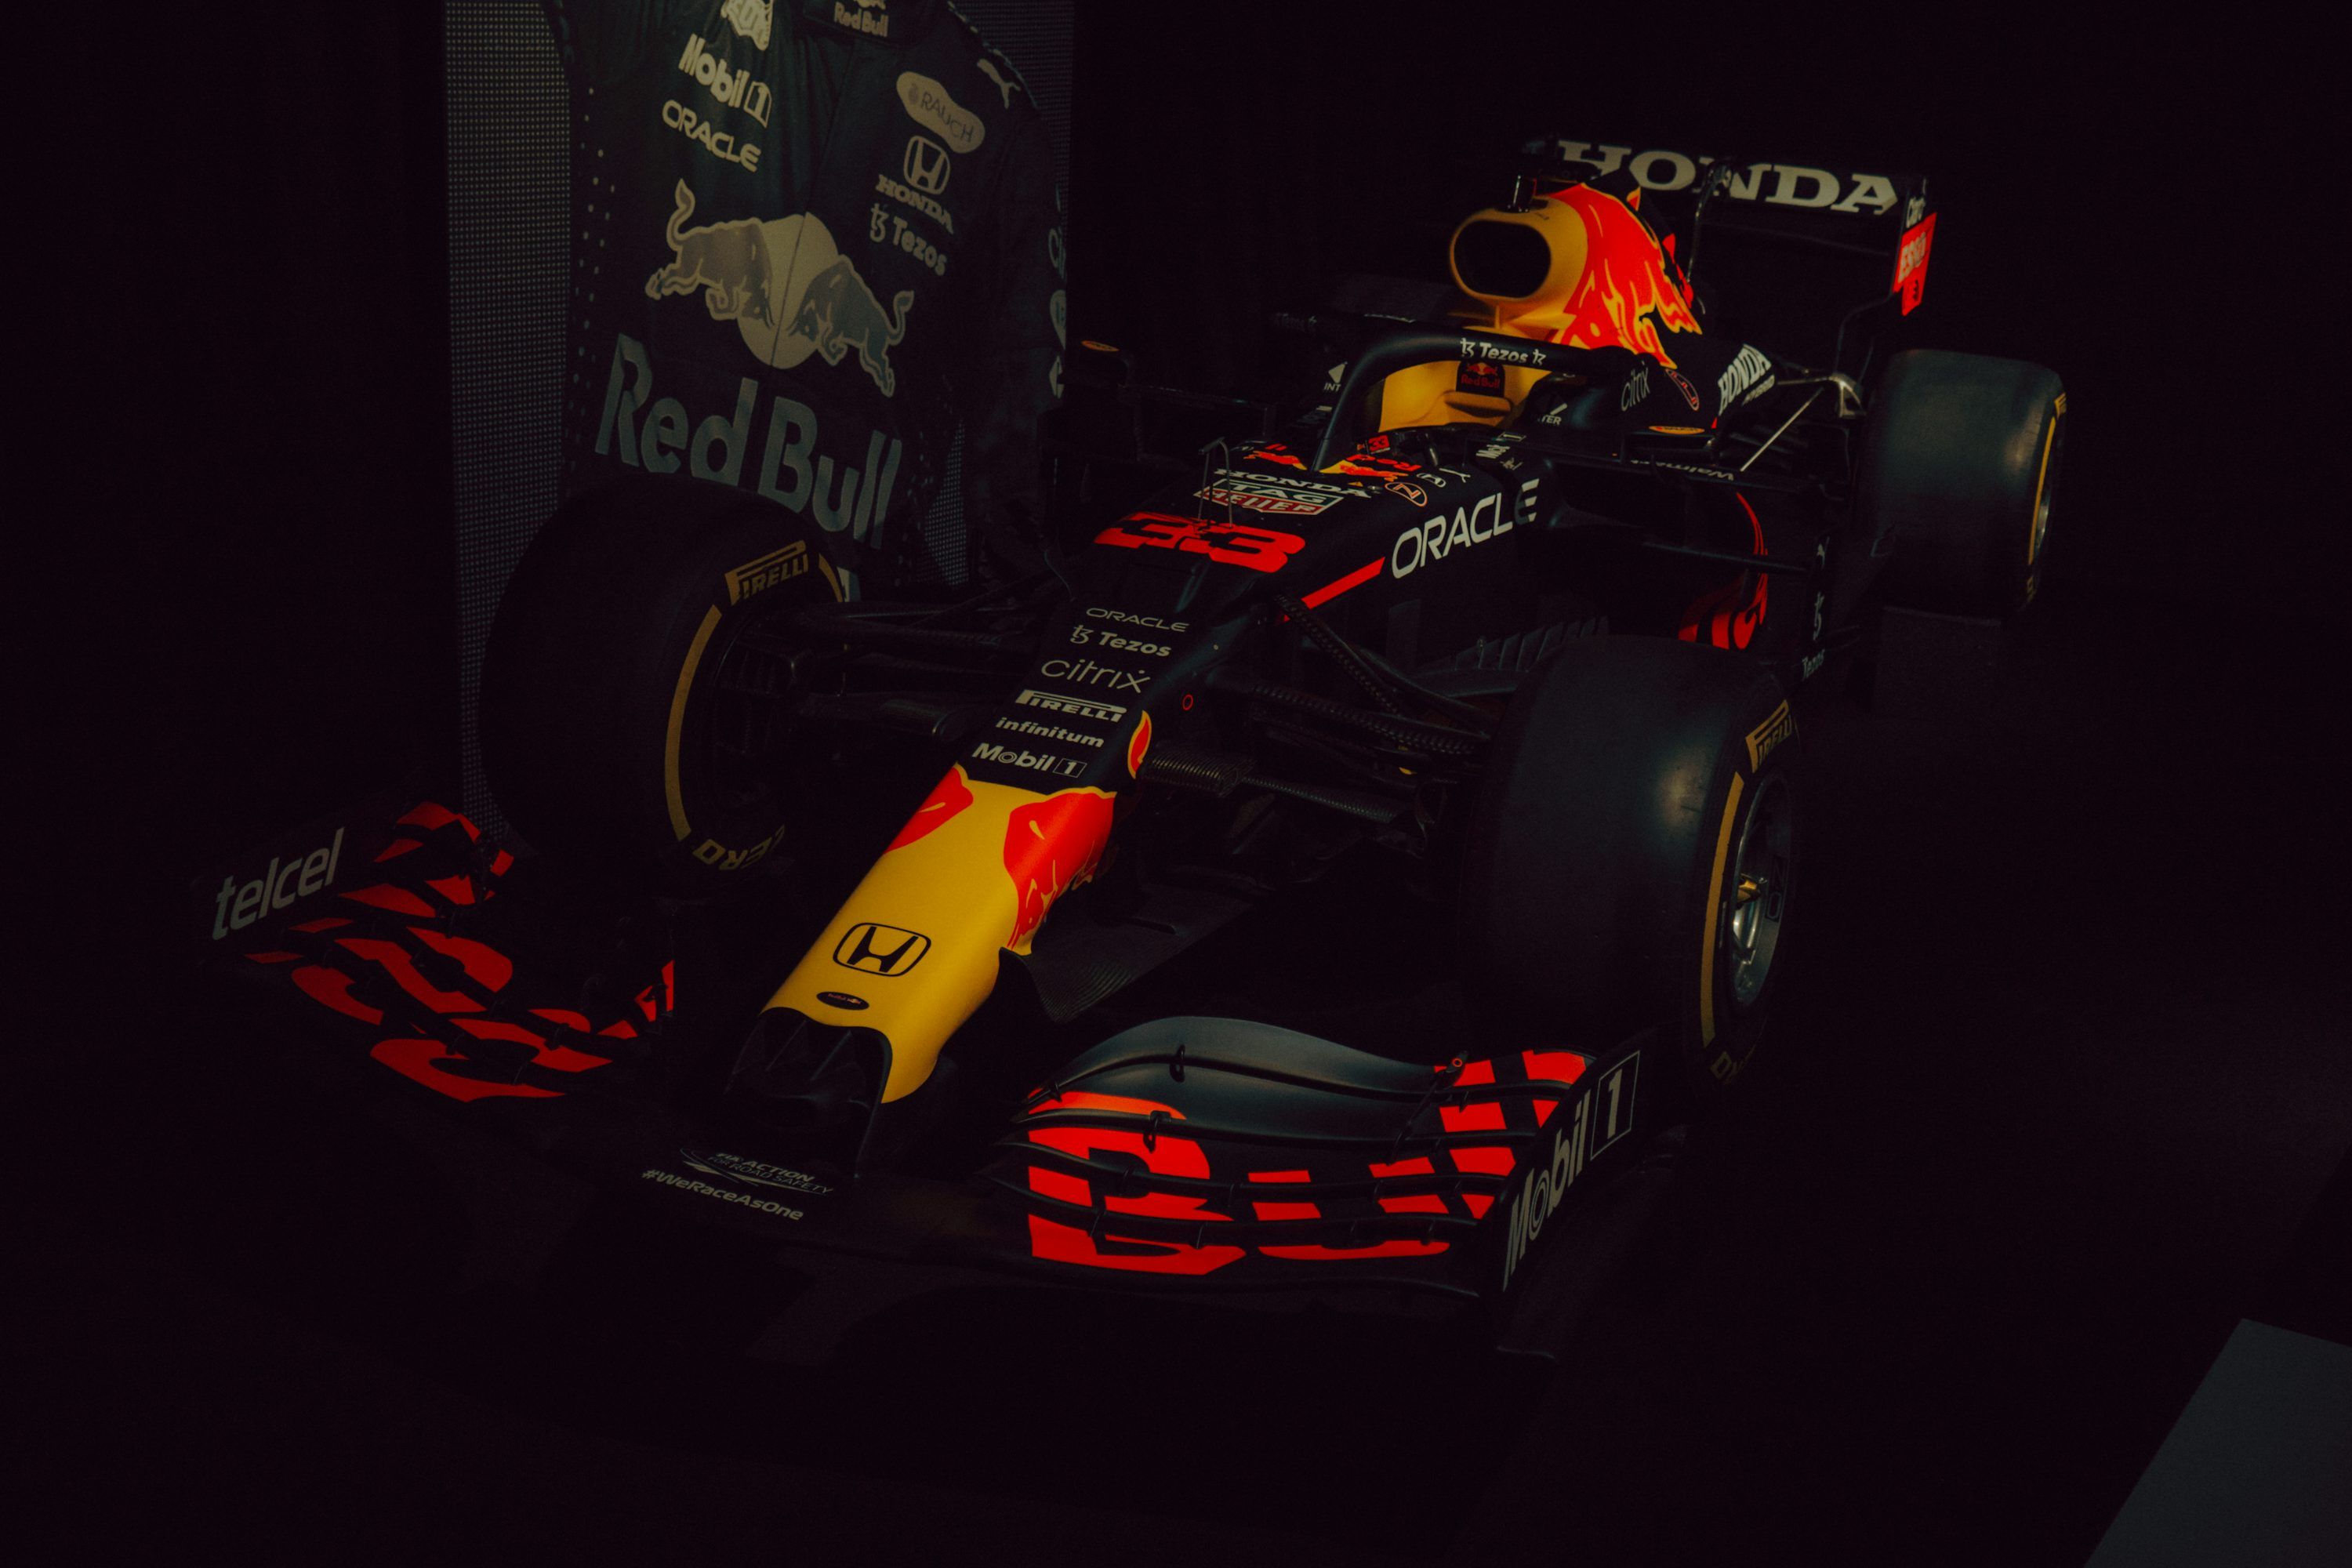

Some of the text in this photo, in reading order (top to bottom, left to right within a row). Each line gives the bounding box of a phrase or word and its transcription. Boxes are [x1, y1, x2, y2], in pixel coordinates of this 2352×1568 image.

[678, 34, 745, 108] Mobil
[662, 100, 761, 172] ORACLE
[919, 90, 975, 143] RAUCH
[875, 174, 954, 234] HONDA
[1558, 140, 1899, 216] HONDA
[891, 217, 948, 276] Tezos
[1479, 342, 1528, 363] Tezos
[1717, 343, 1773, 417] HONDA
[594, 332, 903, 550] Red Bull
[1213, 467, 1372, 499] HONDA
[1232, 481, 1327, 504] TAG
[1391, 478, 1539, 579] ORACLE
[724, 539, 809, 606] PIRELLI
[1086, 607, 1189, 633] ORACLE
[1098, 631, 1172, 658] Tezos
[1040, 657, 1151, 695] citrix
[995, 717, 1105, 748] infinitum
[1015, 690, 1128, 723] PIRELLI
[972, 742, 1056, 772] Mobil
[1745, 699, 1793, 774] PIRELLI
[212, 826, 345, 941] telcel
[641, 1168, 804, 1221] #WeRaceAsOne
[745, 1160, 816, 1182] ACTION
[772, 1172, 834, 1195] SAFETY
[1503, 1090, 1592, 1292] Mobil
